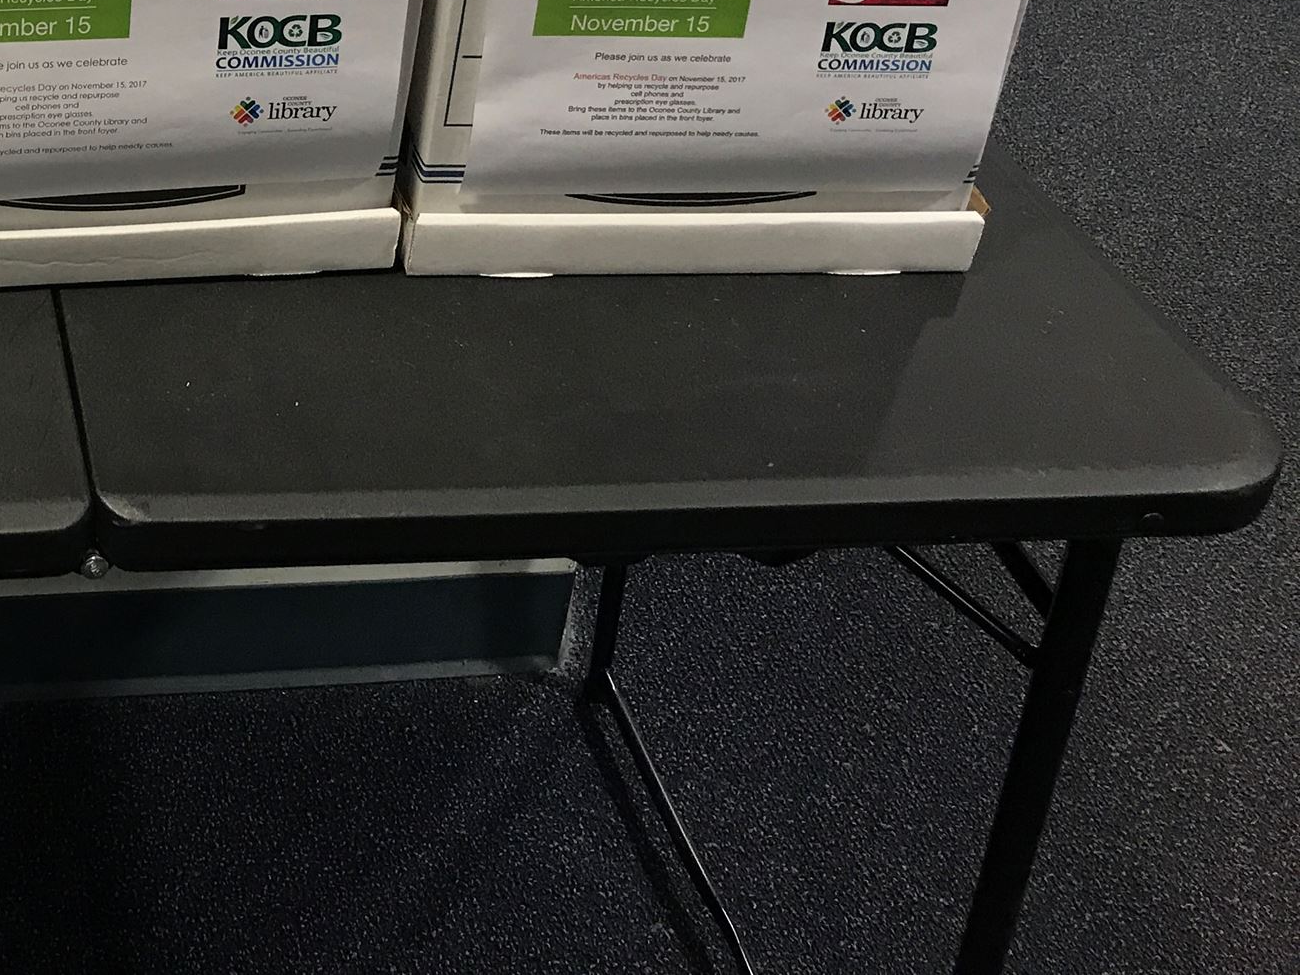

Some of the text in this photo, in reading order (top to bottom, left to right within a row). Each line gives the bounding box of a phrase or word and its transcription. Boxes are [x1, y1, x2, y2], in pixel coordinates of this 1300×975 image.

[65, 16, 90, 33] 15
[218, 14, 343, 49] KOCB
[570, 14, 709, 32] November 15
[822, 22, 939, 53] KOCB
[6, 61, 25, 71] join
[75, 58, 127, 67] celebrate
[215, 53, 340, 70] COMMISSION
[817, 58, 933, 72] COMMISSION
[266, 102, 338, 122] library
[859, 103, 925, 124] library
